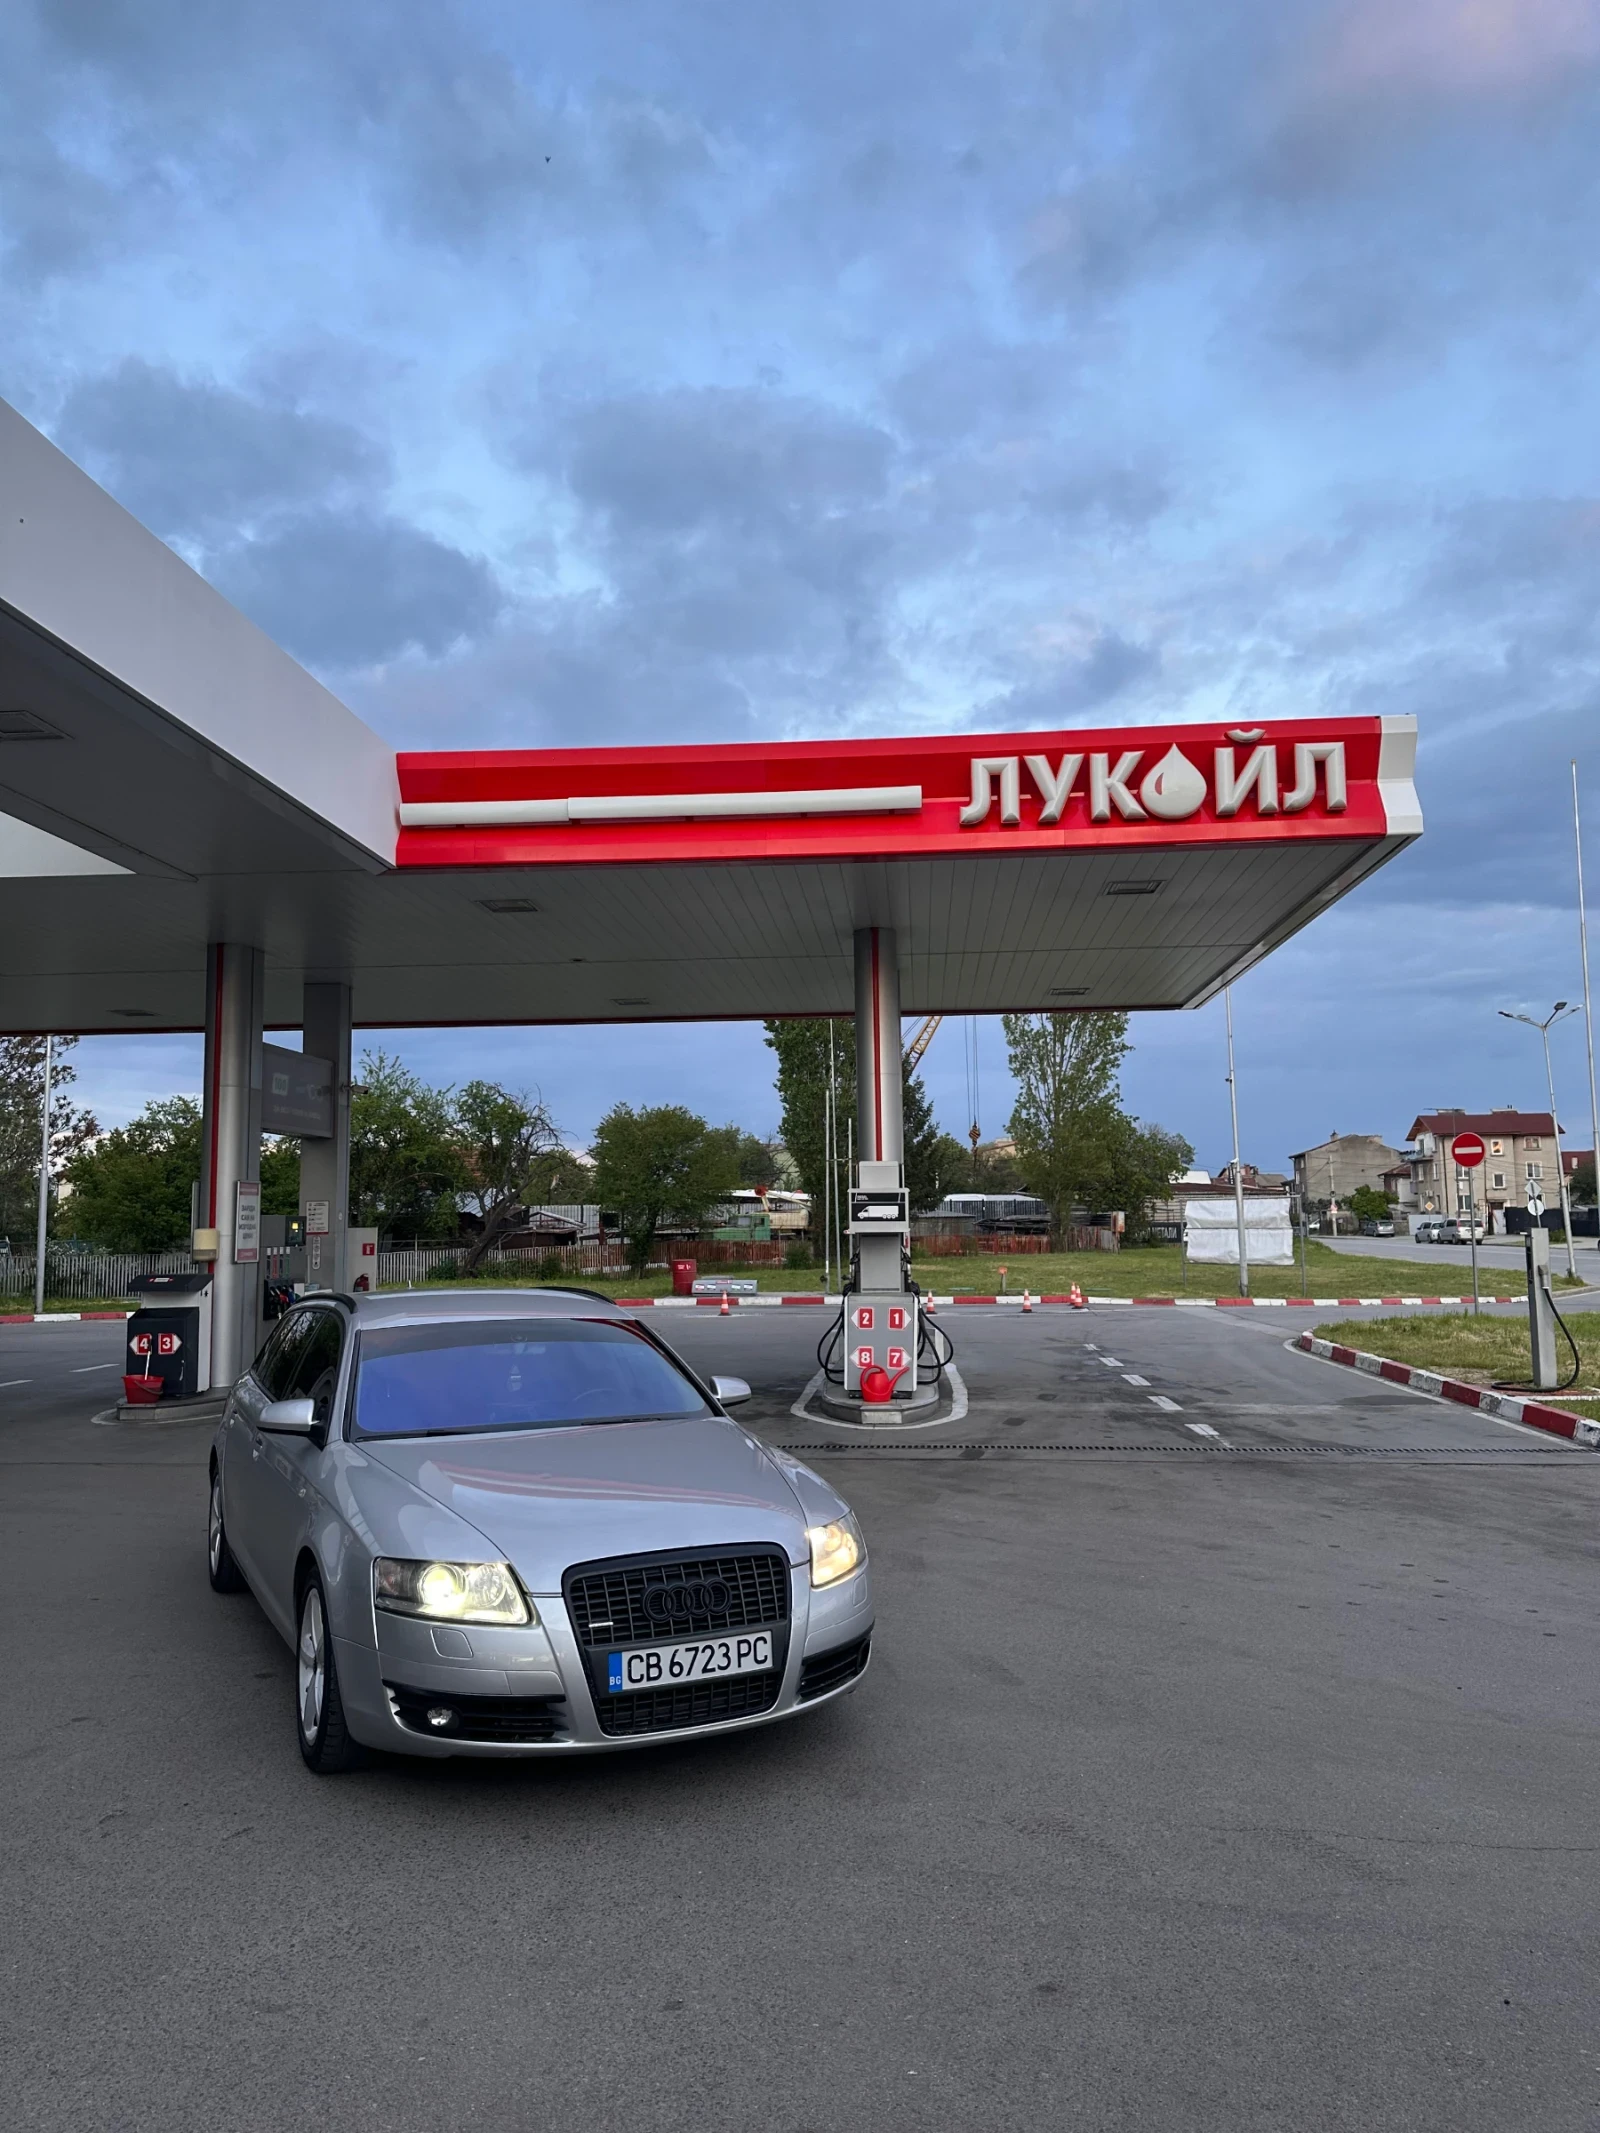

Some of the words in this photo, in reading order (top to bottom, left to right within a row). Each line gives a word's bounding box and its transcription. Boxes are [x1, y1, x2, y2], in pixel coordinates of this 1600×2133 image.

[862, 1312, 870, 1325] 2
[893, 1312, 900, 1325] 1
[139, 1338, 149, 1350] 4
[162, 1337, 171, 1350] 3
[860, 1351, 871, 1364] 8
[890, 1352, 901, 1364] 7
[627, 1652, 663, 1684] CB
[669, 1642, 731, 1678] 6723
[736, 1636, 768, 1668] PC
[609, 1676, 622, 1686] BG
